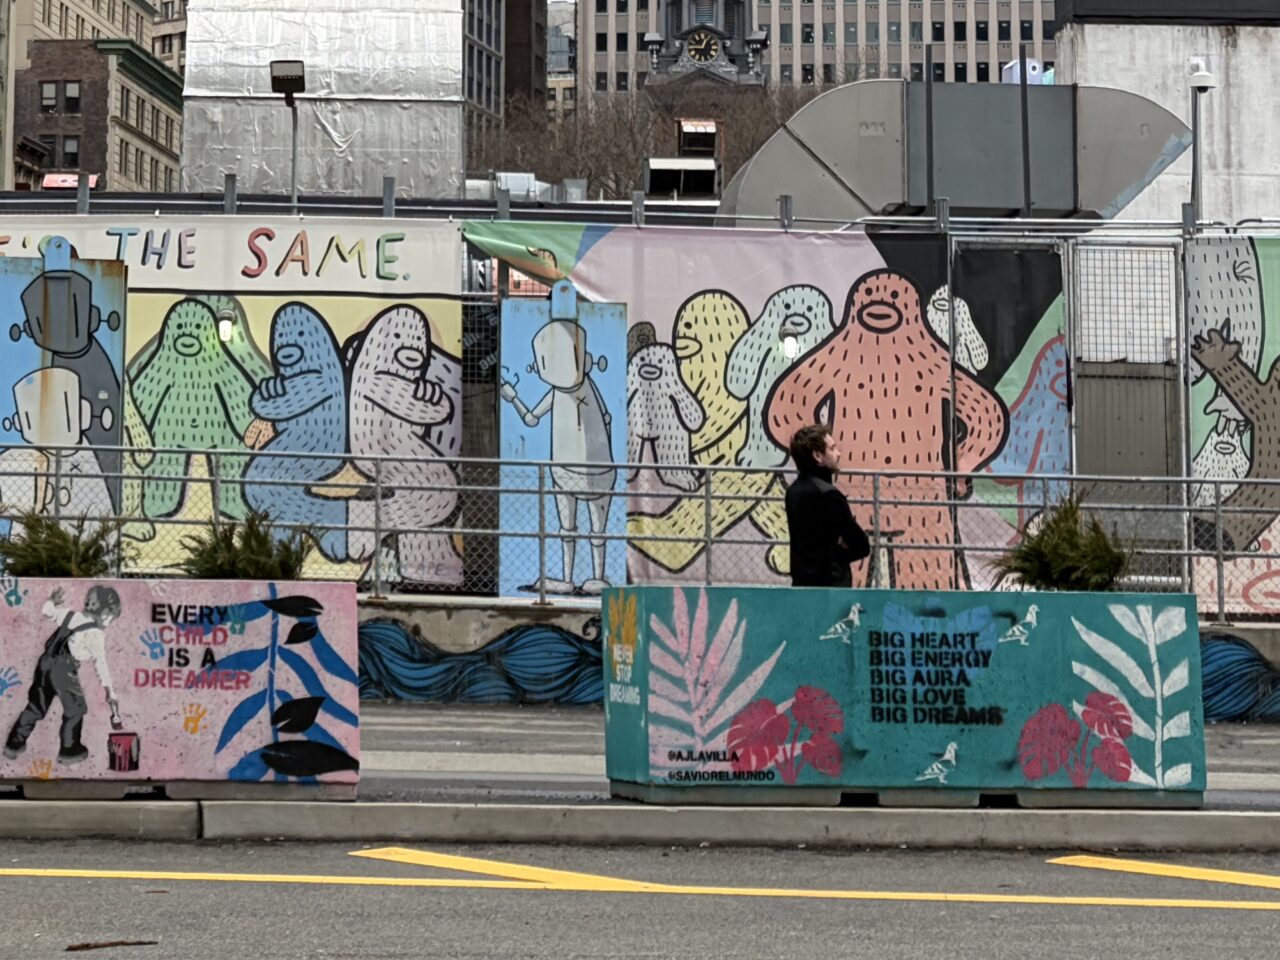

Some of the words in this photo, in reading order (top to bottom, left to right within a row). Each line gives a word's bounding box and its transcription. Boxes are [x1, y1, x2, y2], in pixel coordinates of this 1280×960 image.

[106, 227, 197, 270] THE
[241, 227, 411, 281] SAME.
[151, 603, 231, 623] EVERY
[159, 625, 228, 645] CHILD
[868, 630, 905, 649] BIG
[911, 631, 980, 650] HEART
[168, 647, 190, 668] IS
[201, 647, 217, 667] A
[869, 649, 906, 667] BIG
[911, 649, 992, 668] ENERGY
[133, 668, 252, 690] DREAMER
[870, 669, 907, 686] BIG
[912, 669, 971, 687] AURA
[871, 688, 907, 705] BIG
[912, 688, 966, 705] LOVE
[871, 707, 907, 724] BIG
[913, 706, 1005, 726] DREAMS
